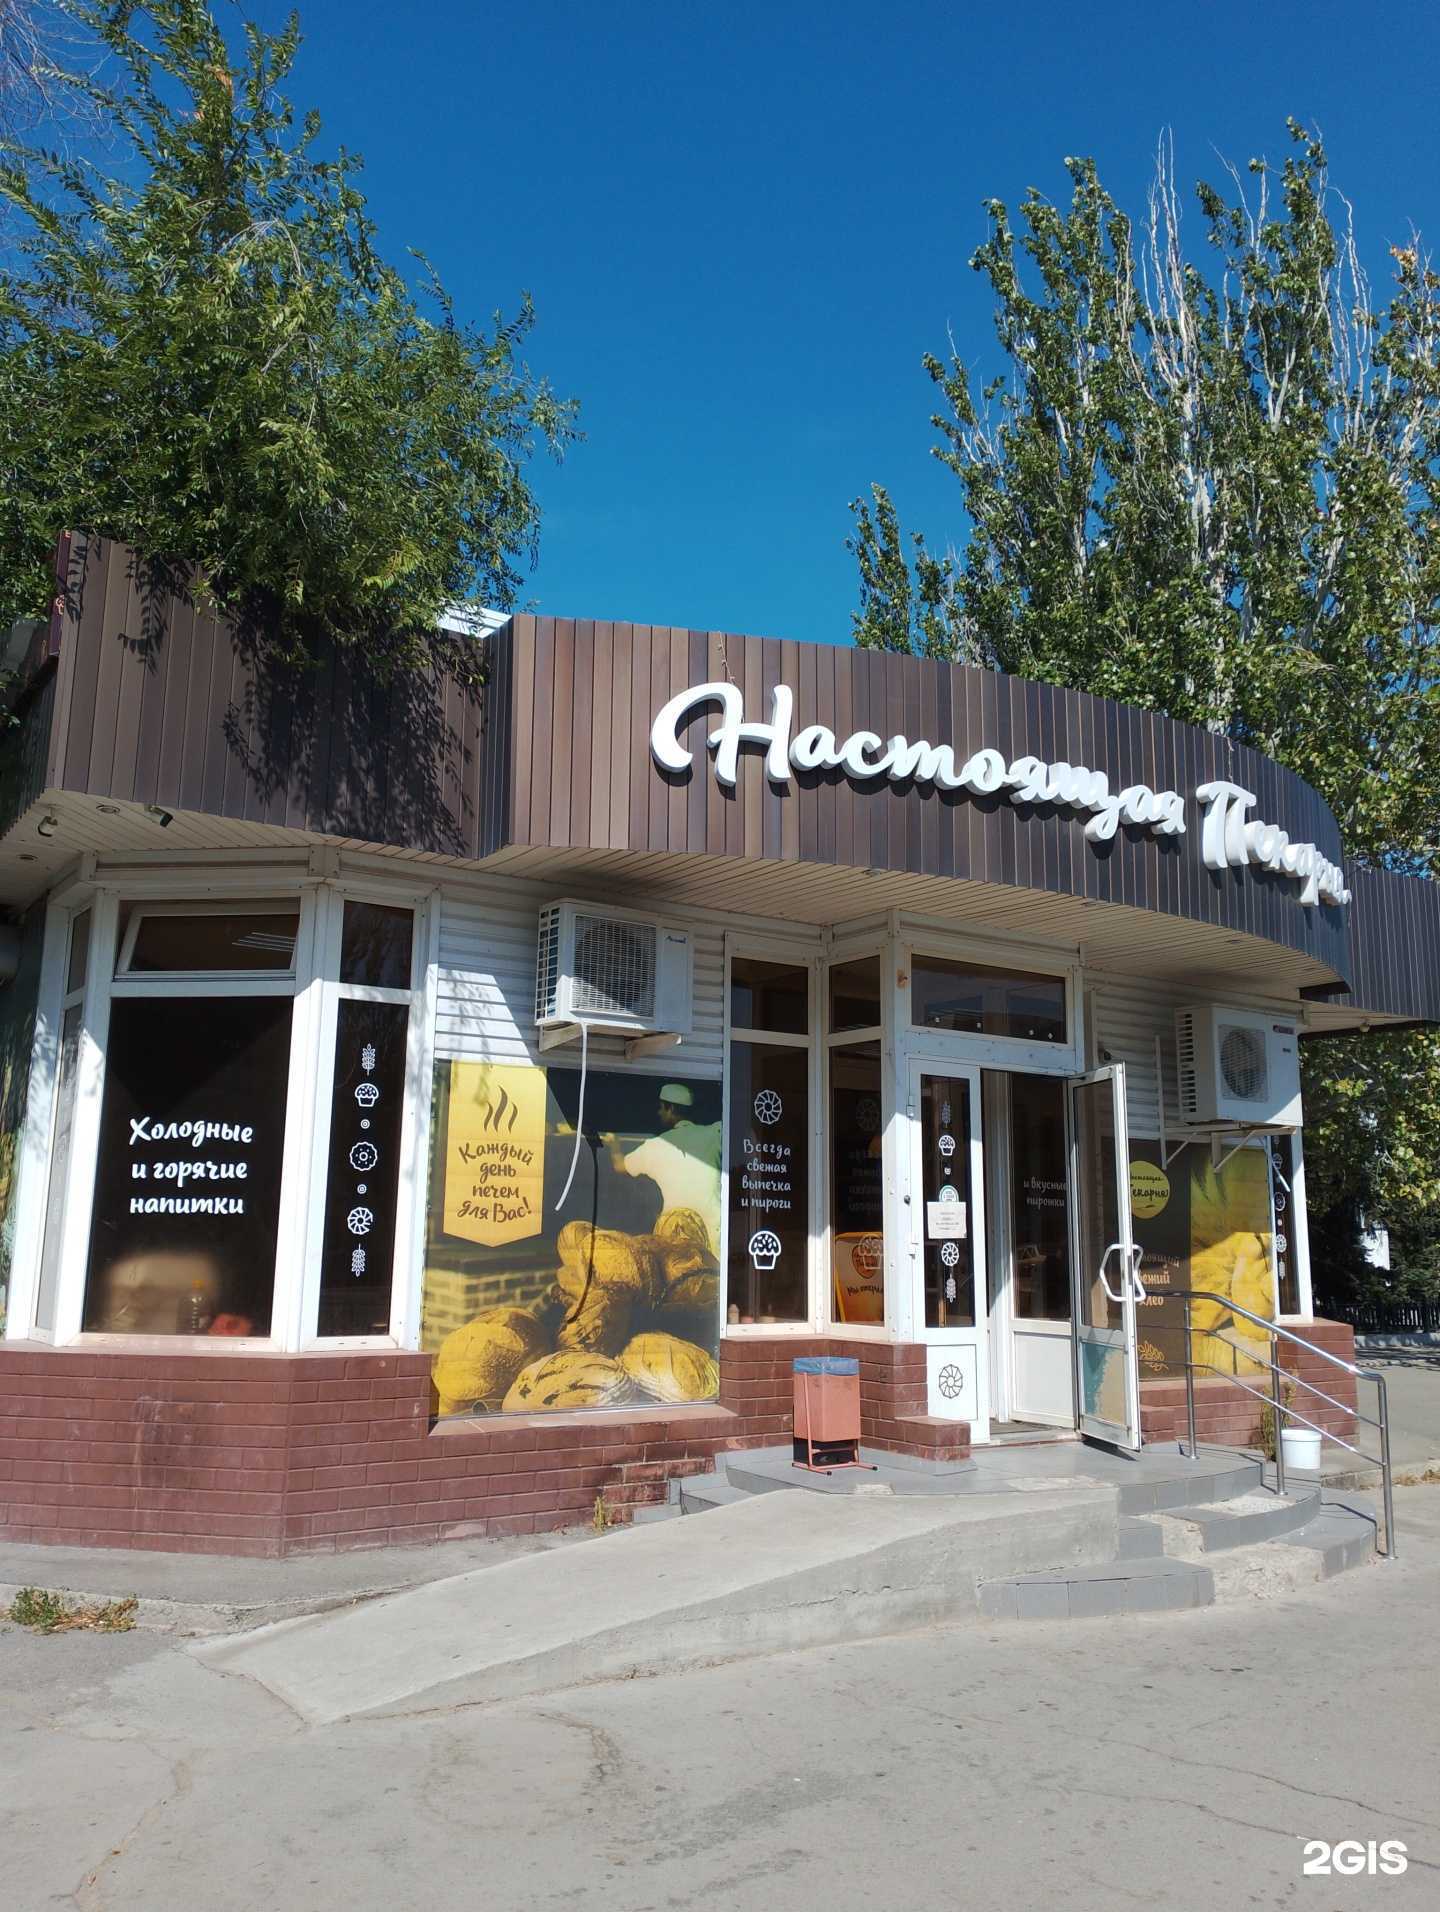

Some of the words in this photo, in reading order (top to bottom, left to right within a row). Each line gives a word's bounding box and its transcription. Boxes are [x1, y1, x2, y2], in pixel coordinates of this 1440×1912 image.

[650, 682, 1186, 842] Настоящая
[128, 1116, 254, 1147] Холодные
[458, 1142, 535, 1166] Каждый
[743, 1138, 791, 1159] Всегда
[131, 1162, 147, 1179] и
[153, 1160, 248, 1187] горячие
[479, 1162, 517, 1184] день
[746, 1157, 787, 1173] свежая
[472, 1184, 520, 1198] печем
[742, 1174, 792, 1191] выпечка
[129, 1197, 244, 1214] напитки
[457, 1200, 489, 1220] для
[493, 1196, 532, 1223] Вас!
[741, 1197, 749, 1207] и
[751, 1198, 792, 1213] пироги
[1026, 1196, 1065, 1210] пирожки
